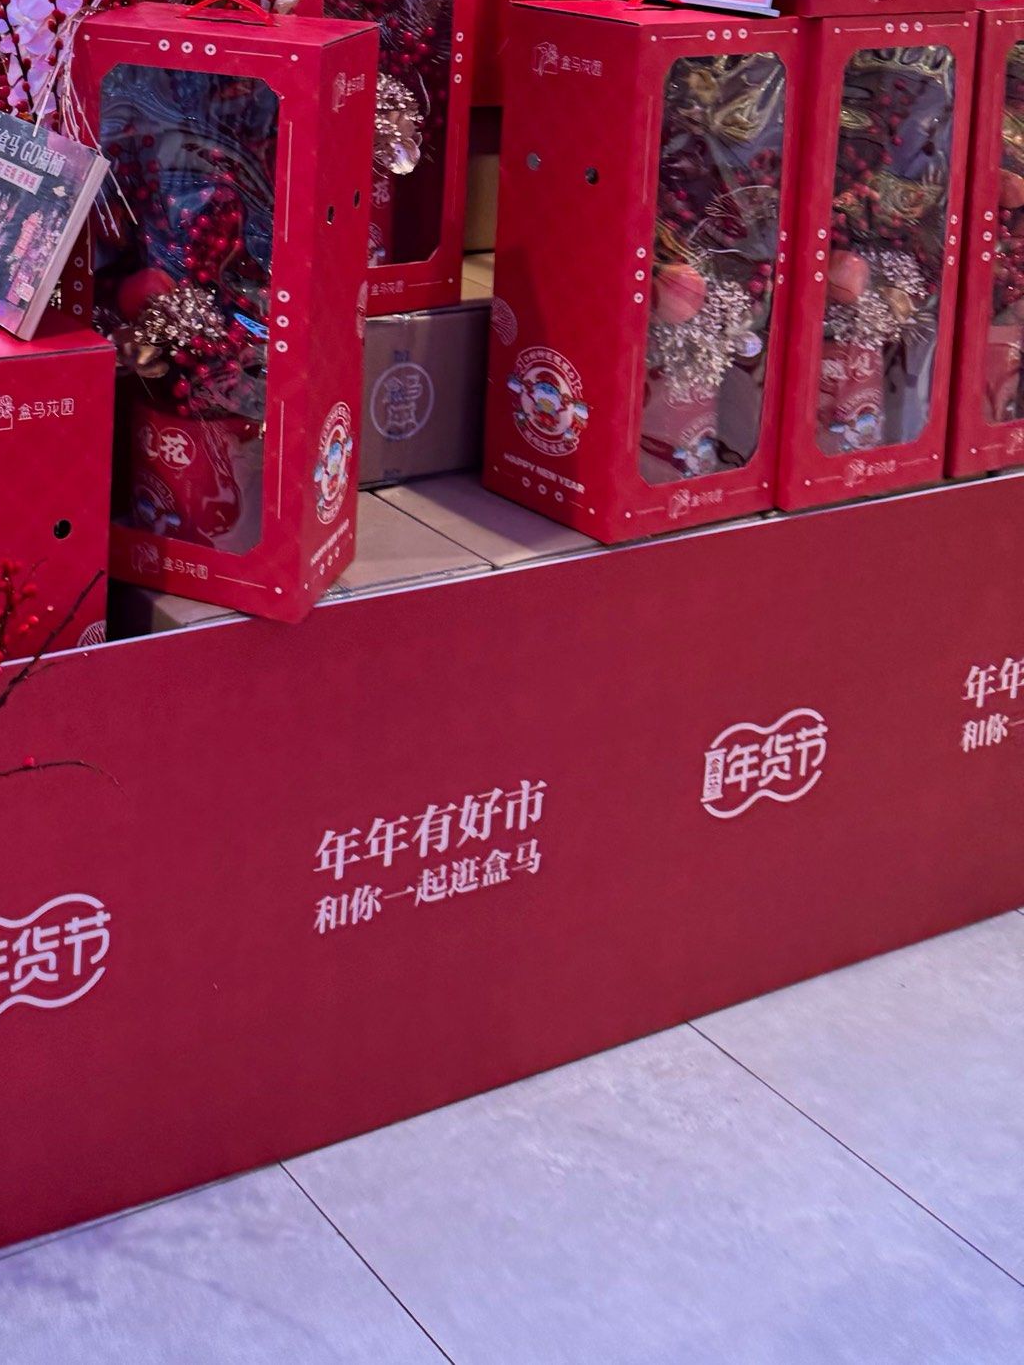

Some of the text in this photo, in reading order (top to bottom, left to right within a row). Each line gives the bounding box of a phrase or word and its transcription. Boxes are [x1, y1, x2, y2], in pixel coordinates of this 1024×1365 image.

[560, 56, 602, 77] 盒马花园
[16, 398, 75, 420] 盒马花园
[724, 723, 828, 793] 年货节
[313, 779, 548, 881] 年年有好市
[313, 838, 543, 935] 和你一起逛盒马
